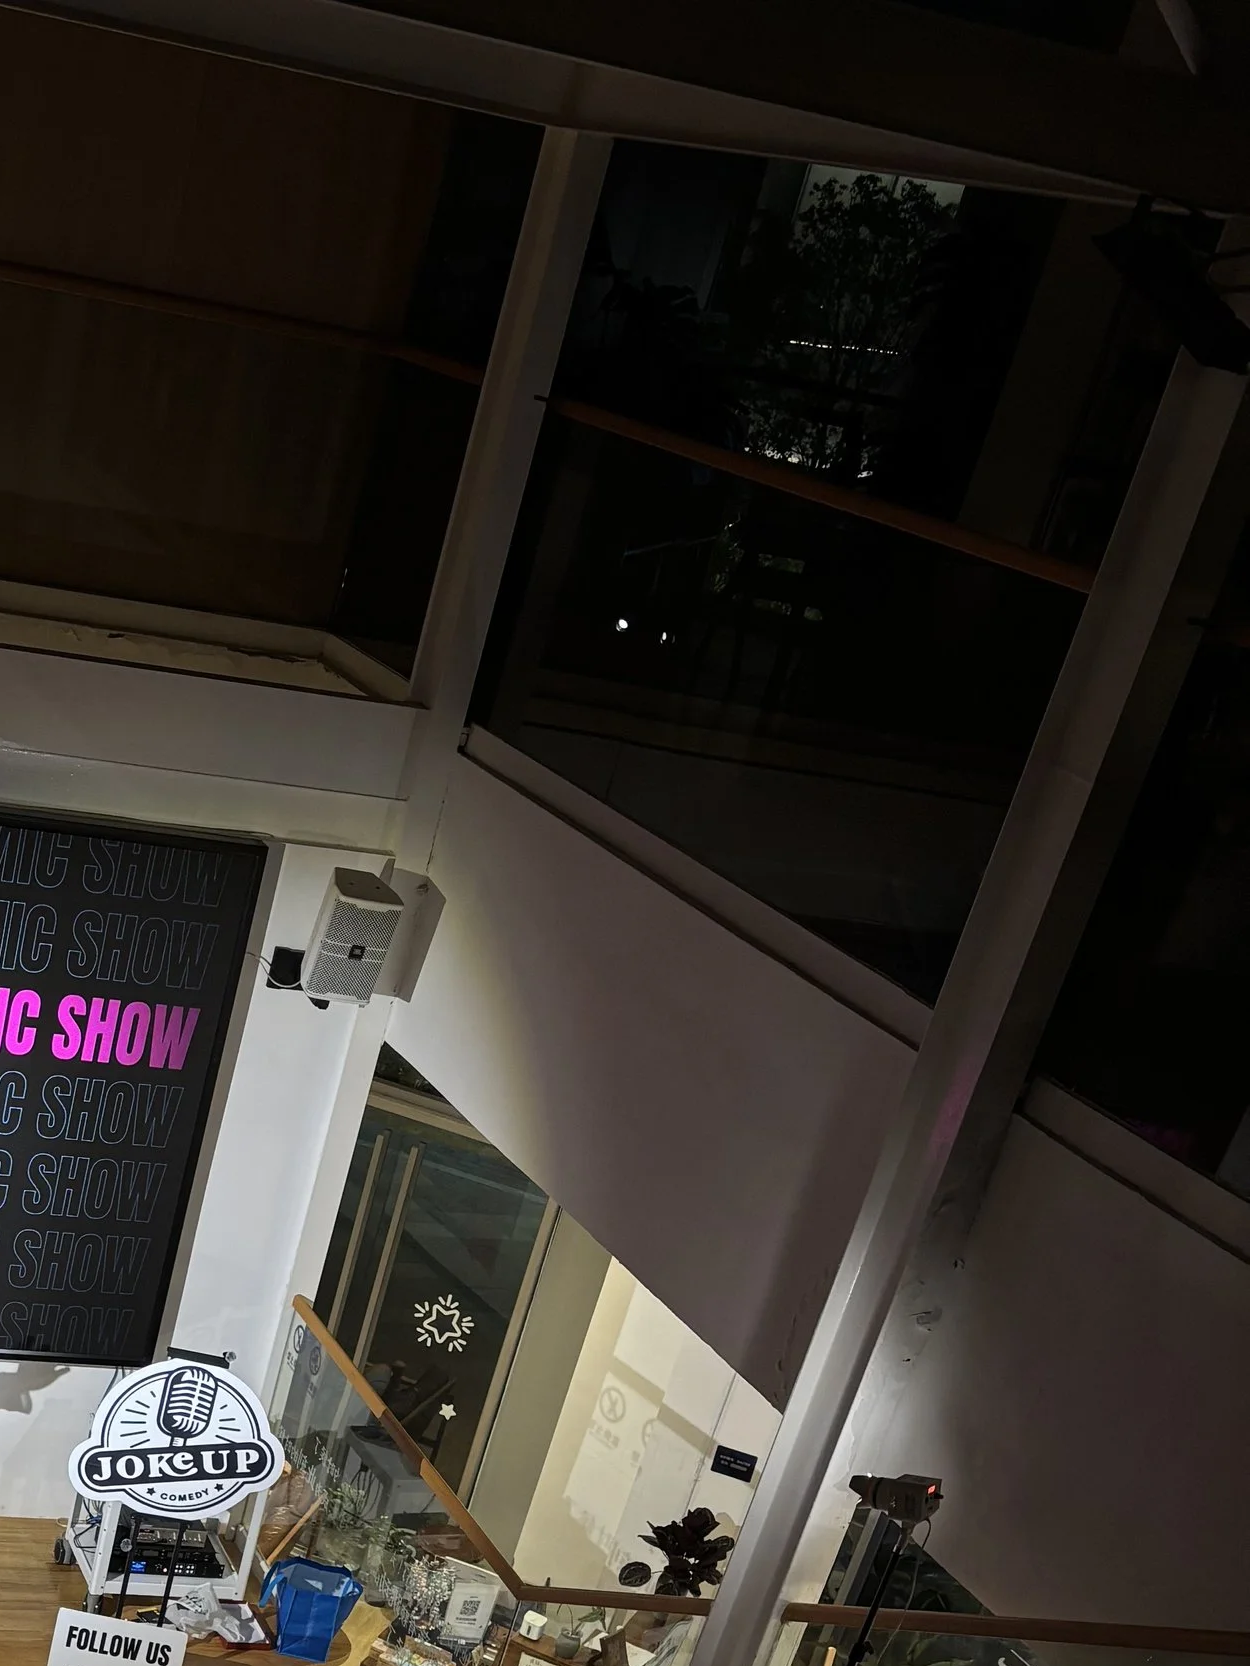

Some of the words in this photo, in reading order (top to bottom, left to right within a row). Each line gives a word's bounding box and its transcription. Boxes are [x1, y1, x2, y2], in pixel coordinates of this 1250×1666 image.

[66, 909, 219, 990] SHOW
[50, 993, 202, 1071] SHOW
[36, 1074, 185, 1149] SHOW
[22, 1152, 167, 1224] SHOW
[8, 1227, 151, 1296] SHOW
[160, 1488, 210, 1502] COMEDY
[65, 1625, 143, 1661] FOLLOW
[145, 1641, 172, 1666] US
